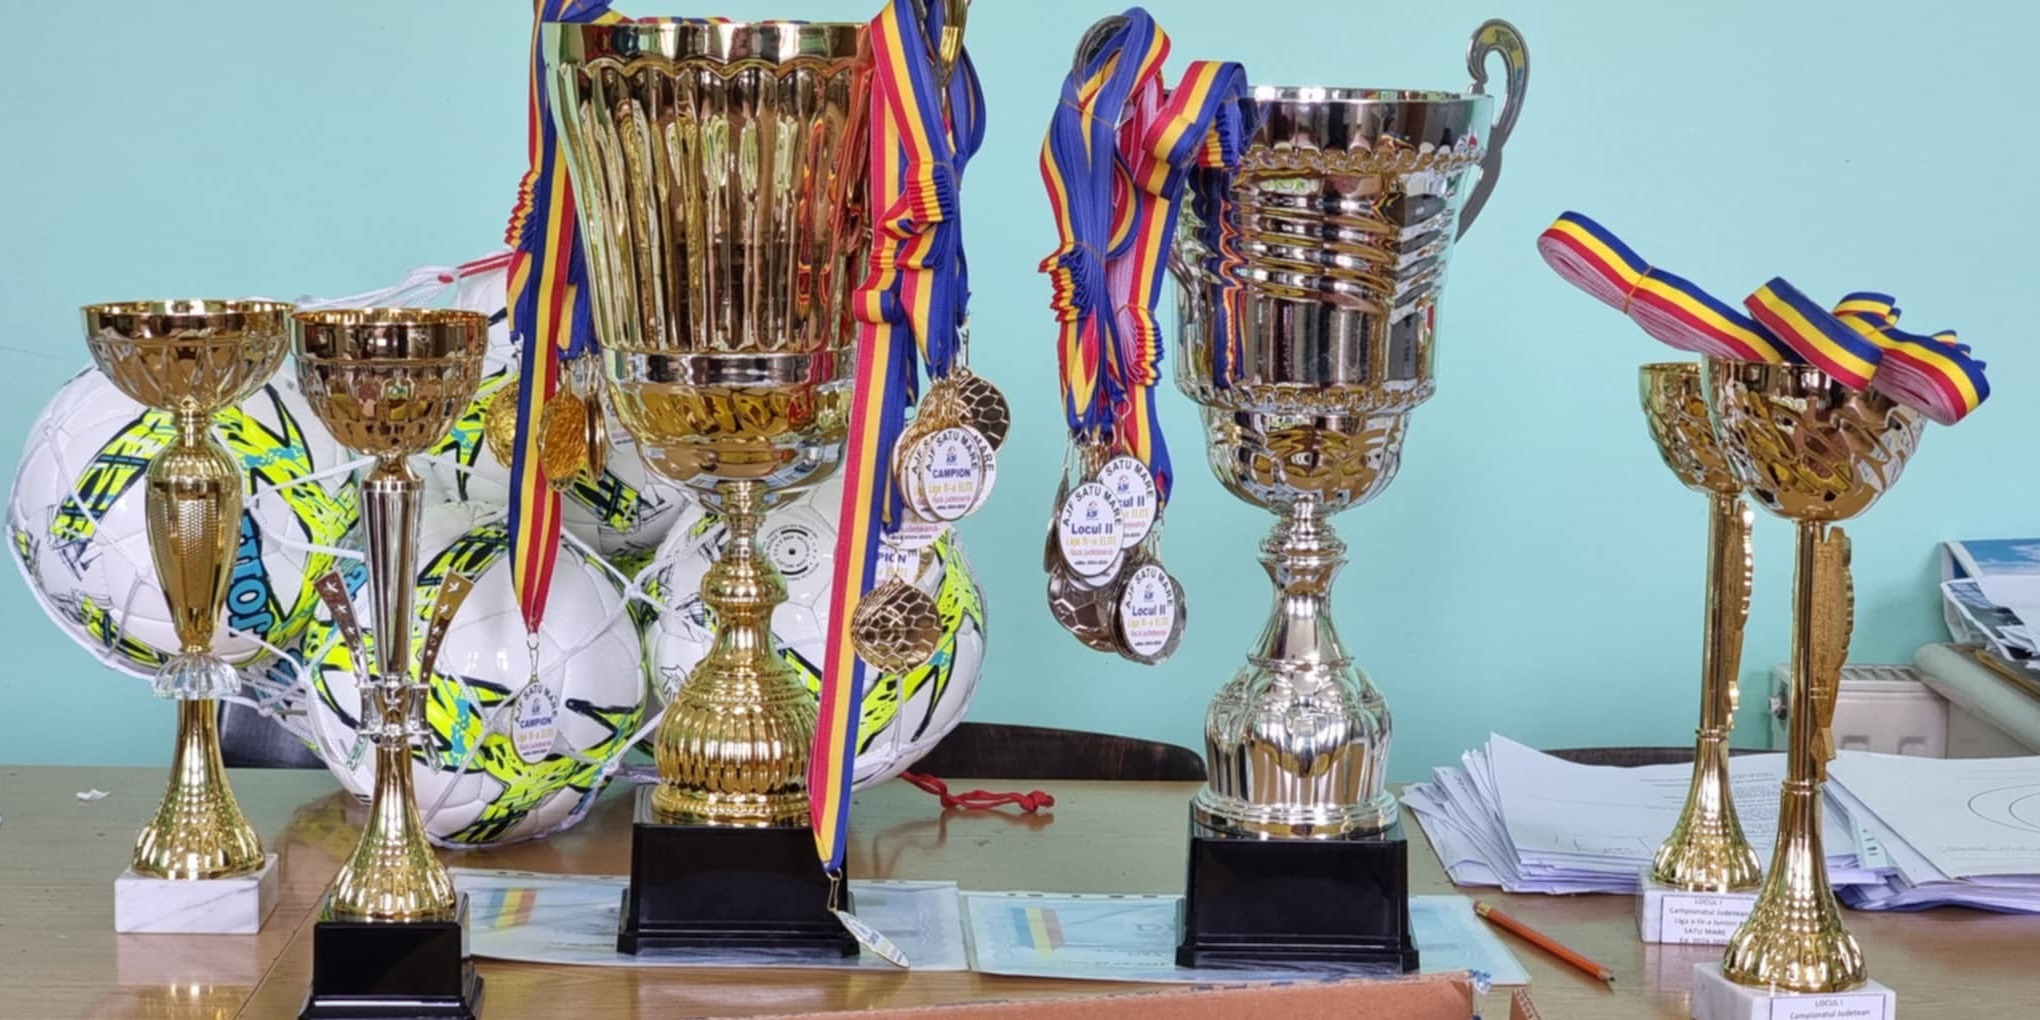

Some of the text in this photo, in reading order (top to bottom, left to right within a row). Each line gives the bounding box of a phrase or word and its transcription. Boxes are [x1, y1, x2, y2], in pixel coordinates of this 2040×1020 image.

[936, 430, 959, 447] SATU
[962, 436, 978, 470] MARE
[932, 468, 971, 478] CAMPION
[1106, 460, 1154, 498] SATU MARE
[1062, 486, 1121, 526] AJF SATU MARE
[1118, 496, 1145, 508] cul II
[1071, 524, 1101, 534] Locul
[1105, 523, 1113, 533] II
[1126, 568, 1173, 609] AJF SATU MARE
[1132, 605, 1166, 616] Locul II
[520, 717, 552, 728] CAMPION
[1669, 907, 1715, 916] Campionatul
[1789, 1011, 1836, 1020] Campionatul
